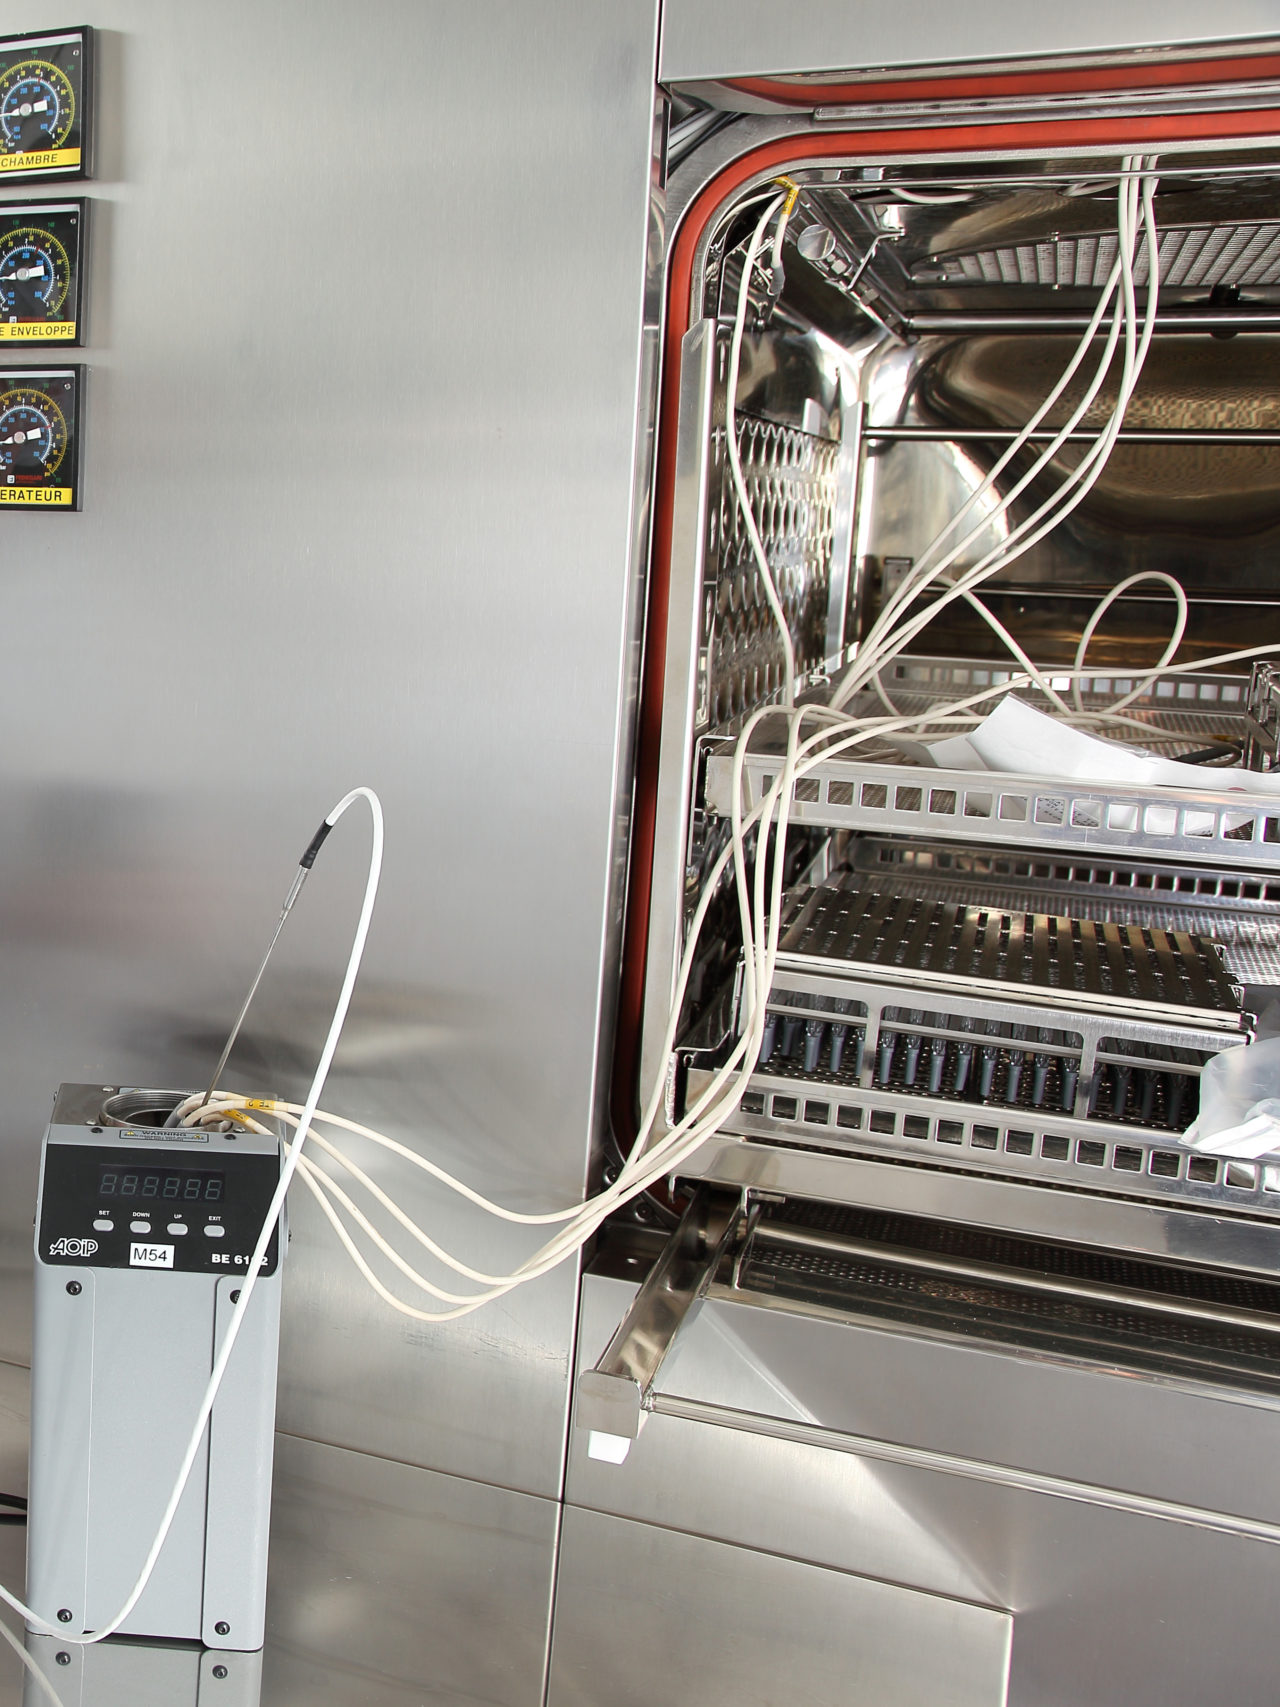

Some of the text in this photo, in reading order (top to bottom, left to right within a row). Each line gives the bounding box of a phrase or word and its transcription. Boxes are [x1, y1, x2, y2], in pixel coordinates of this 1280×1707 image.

[0, 154, 58, 168] CHAMBRE
[11, 325, 74, 336] ENVELOPPE
[133, 1247, 168, 1262] M54
[211, 1253, 268, 1266] BE 612
